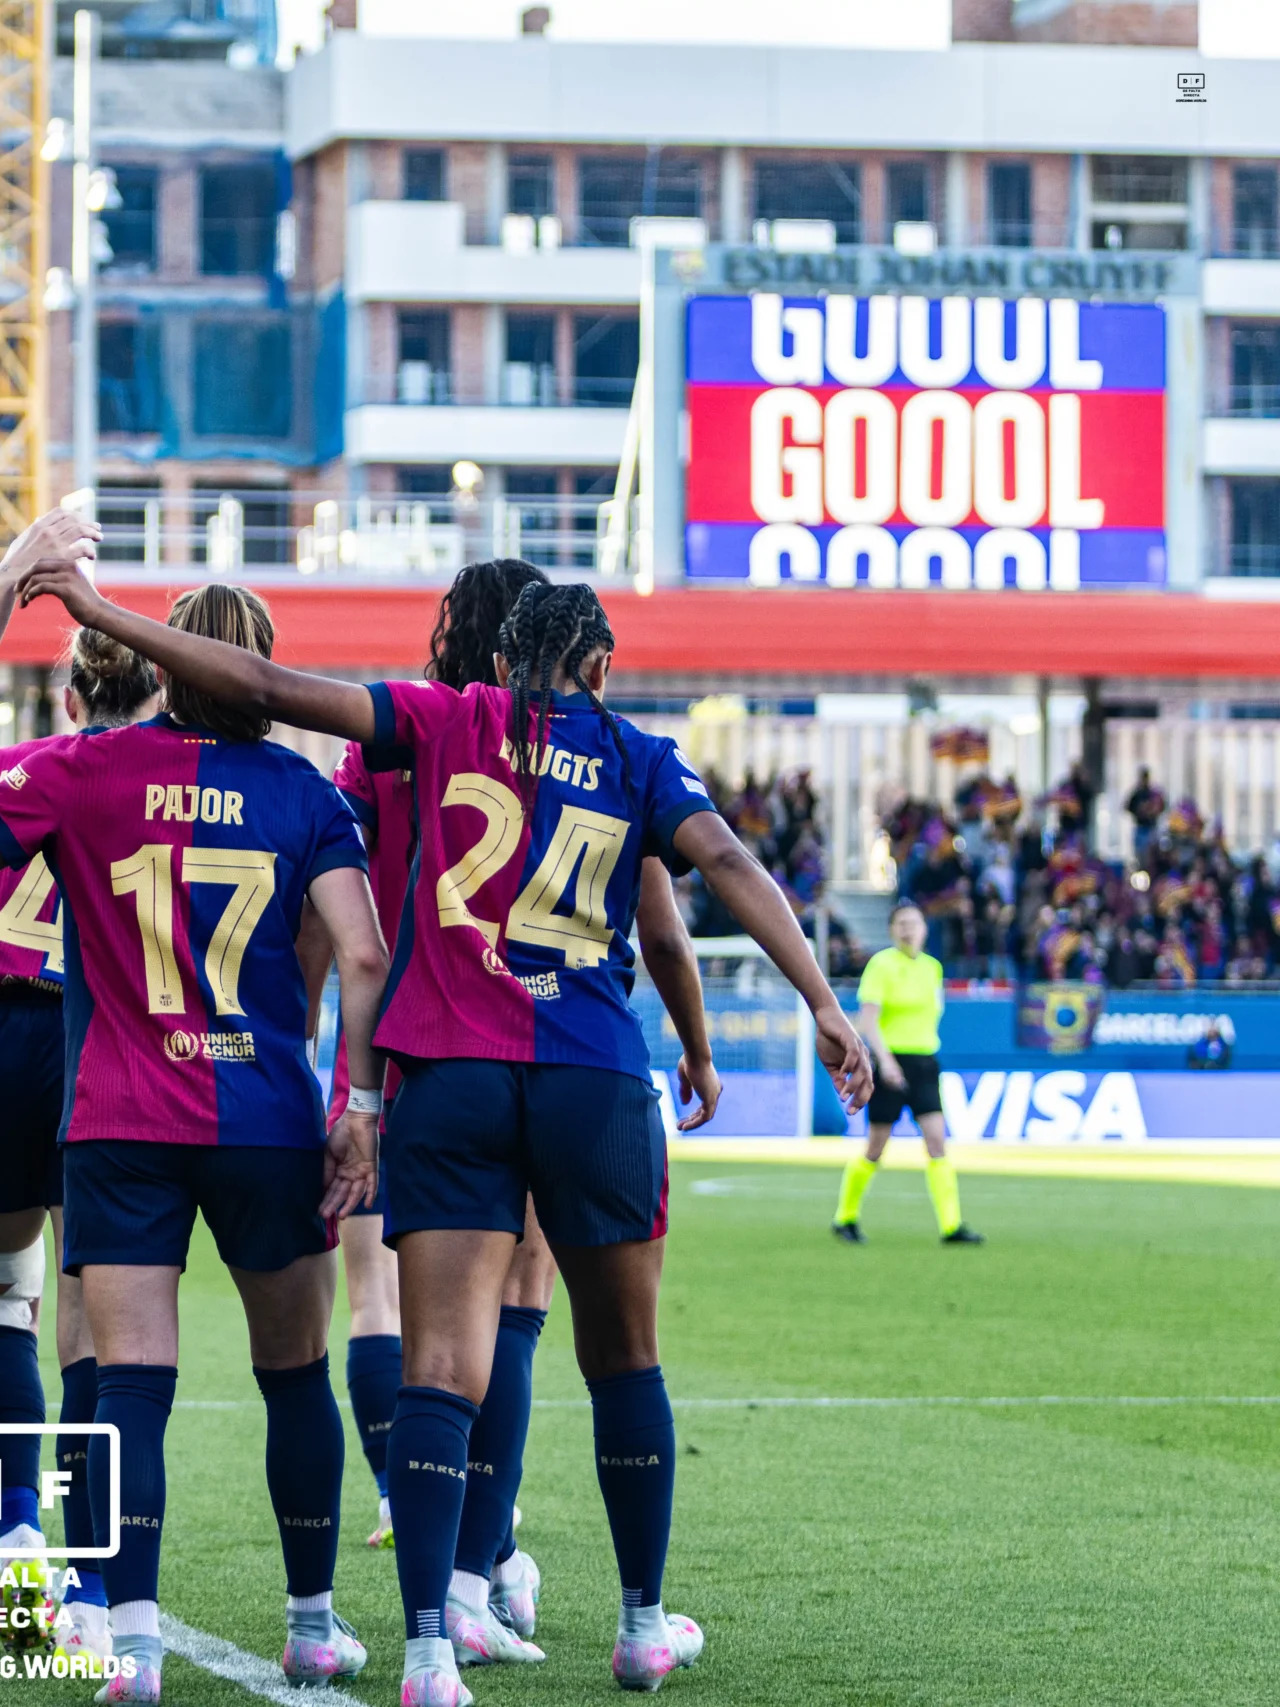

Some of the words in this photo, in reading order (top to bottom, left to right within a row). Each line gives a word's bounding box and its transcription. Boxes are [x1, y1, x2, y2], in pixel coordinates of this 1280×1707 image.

[723, 250, 860, 288] ESTADI
[876, 252, 1009, 289] JOHAN
[1023, 254, 1176, 291] CRUYFF
[750, 386, 1105, 530] GOOOL
[145, 784, 244, 826] PAJOR
[437, 773, 631, 970] 24
[111, 844, 278, 1017] 17
[200, 1032, 254, 1044] UNHCR
[202, 1044, 255, 1057] ACNUR
[939, 1071, 1148, 1140] VISA
